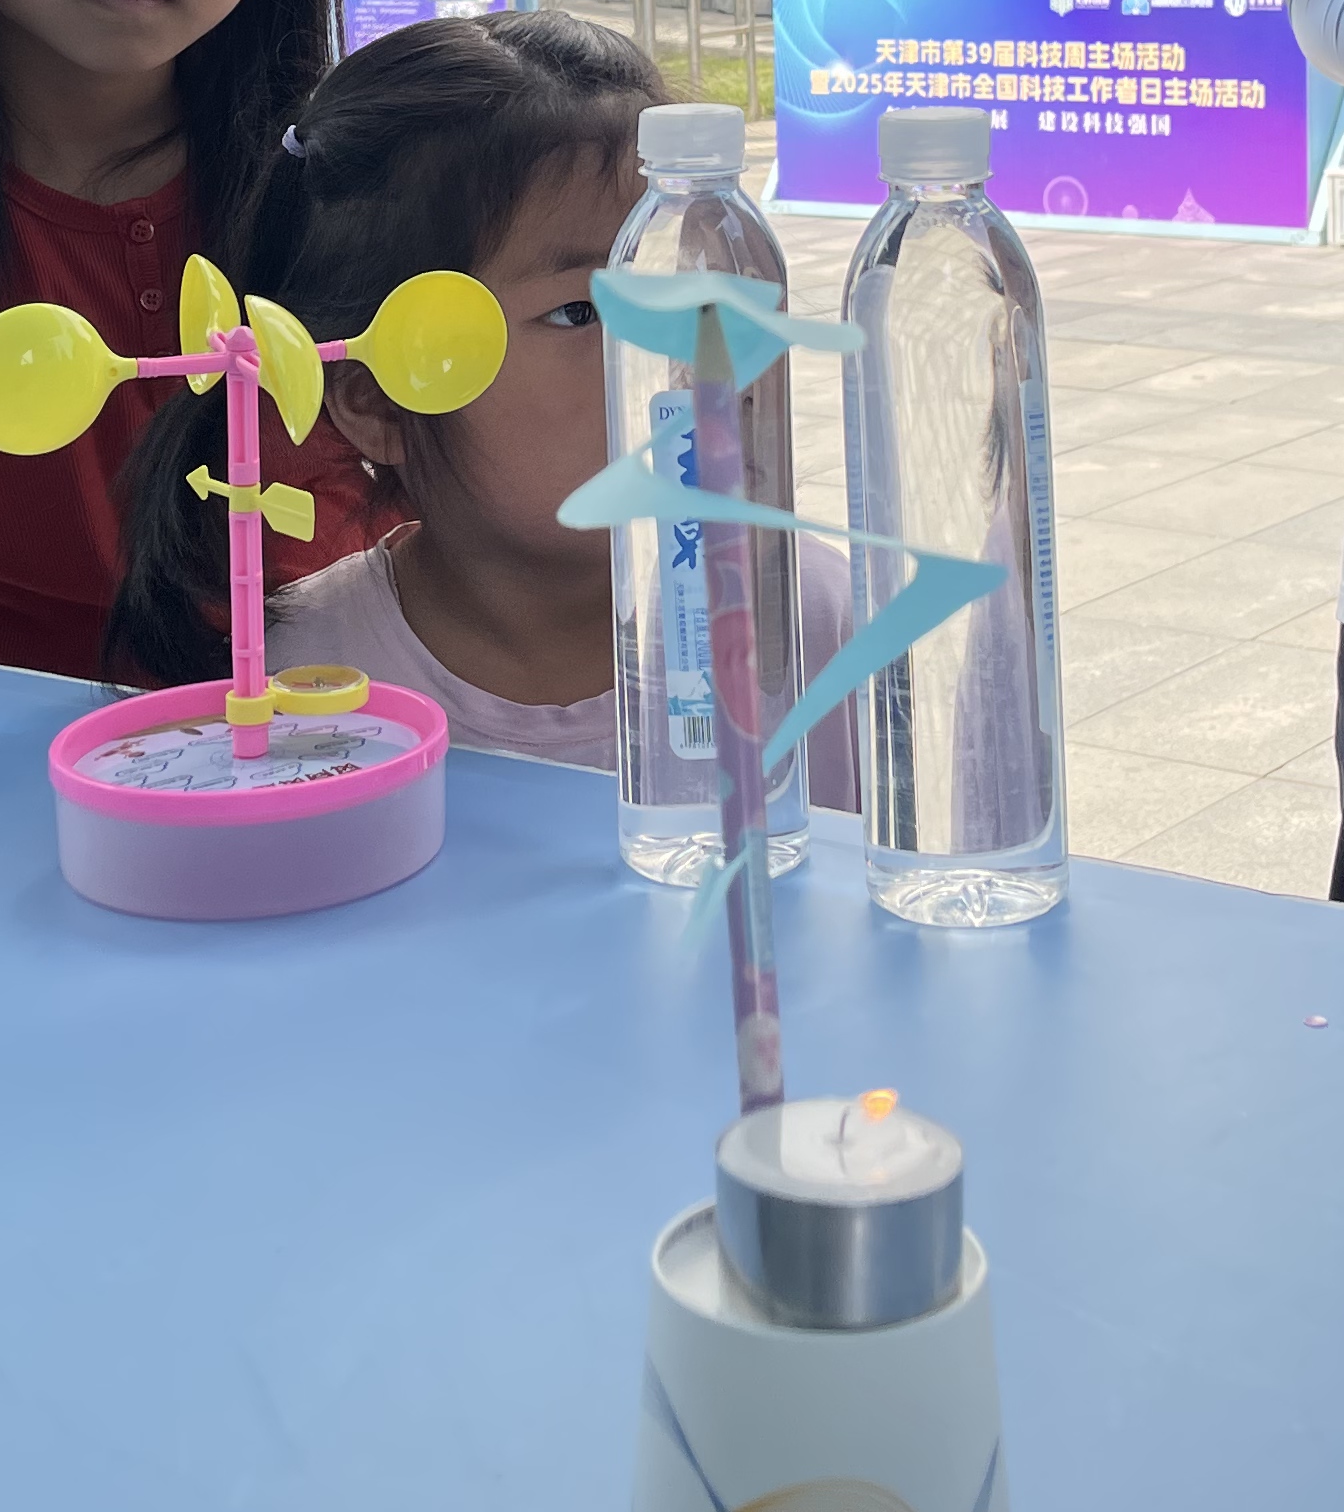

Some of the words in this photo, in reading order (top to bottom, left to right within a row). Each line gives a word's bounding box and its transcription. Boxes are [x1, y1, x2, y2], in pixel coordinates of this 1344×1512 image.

[875, 39, 1187, 72] 天津市第39届科技周主场活动
[809, 69, 1267, 109] 暨2025年天津市全国科技工作者日主场活动
